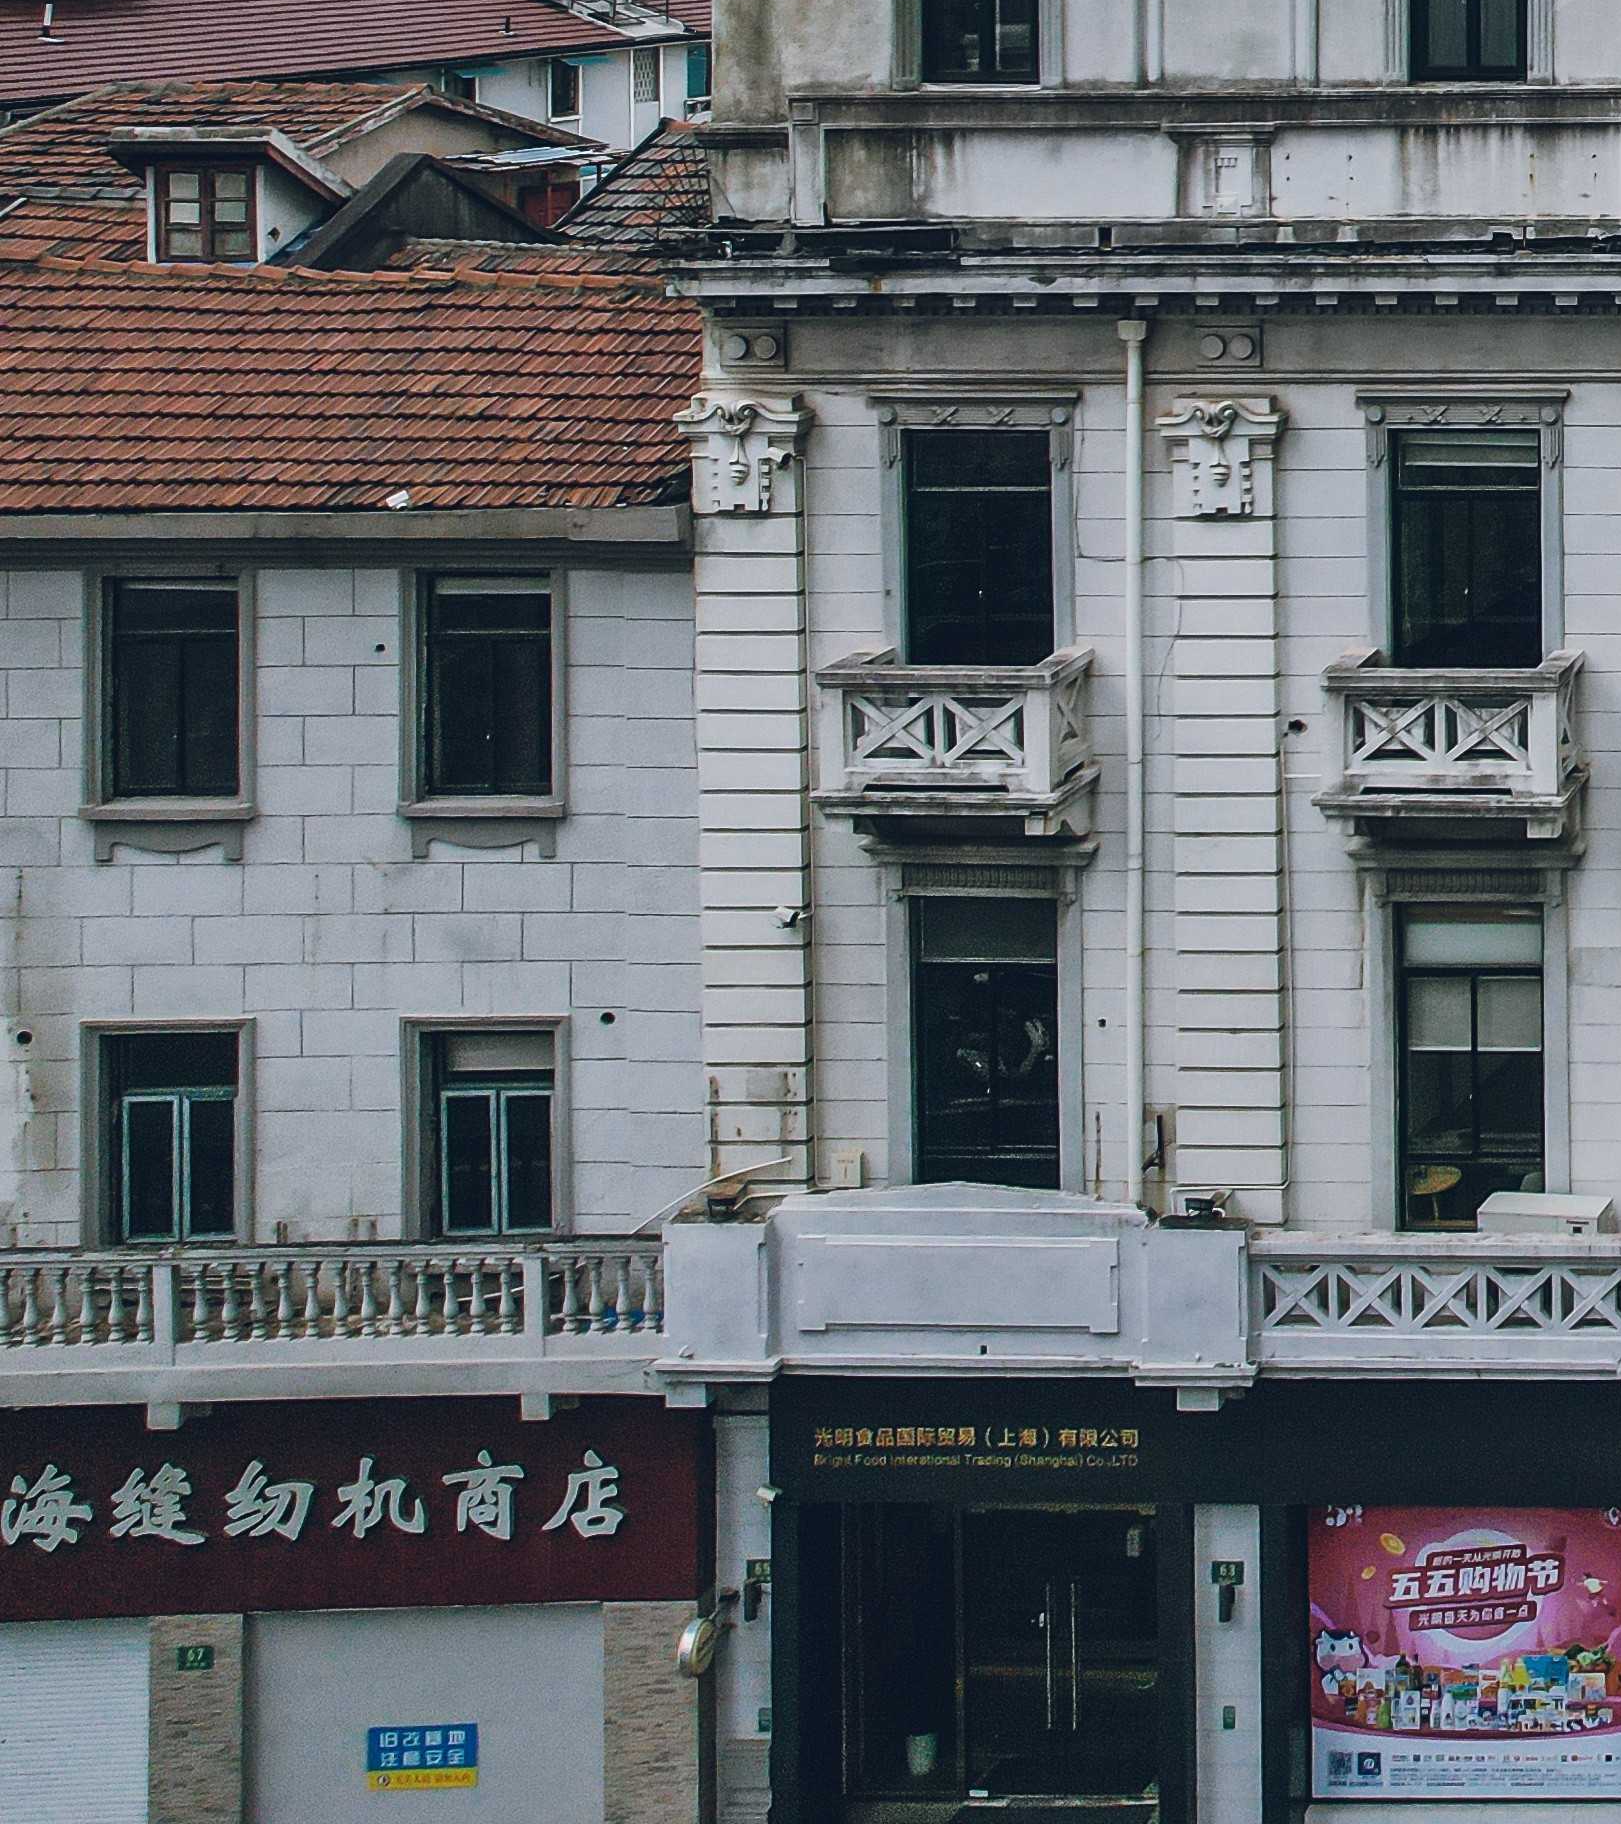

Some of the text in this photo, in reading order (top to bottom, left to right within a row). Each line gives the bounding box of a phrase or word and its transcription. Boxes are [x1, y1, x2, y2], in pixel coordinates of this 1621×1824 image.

[855, 1454, 887, 1466] Food
[0, 1449, 624, 1552] 海缝纫机商店
[1389, 1559, 1560, 1603] 五五购物节
